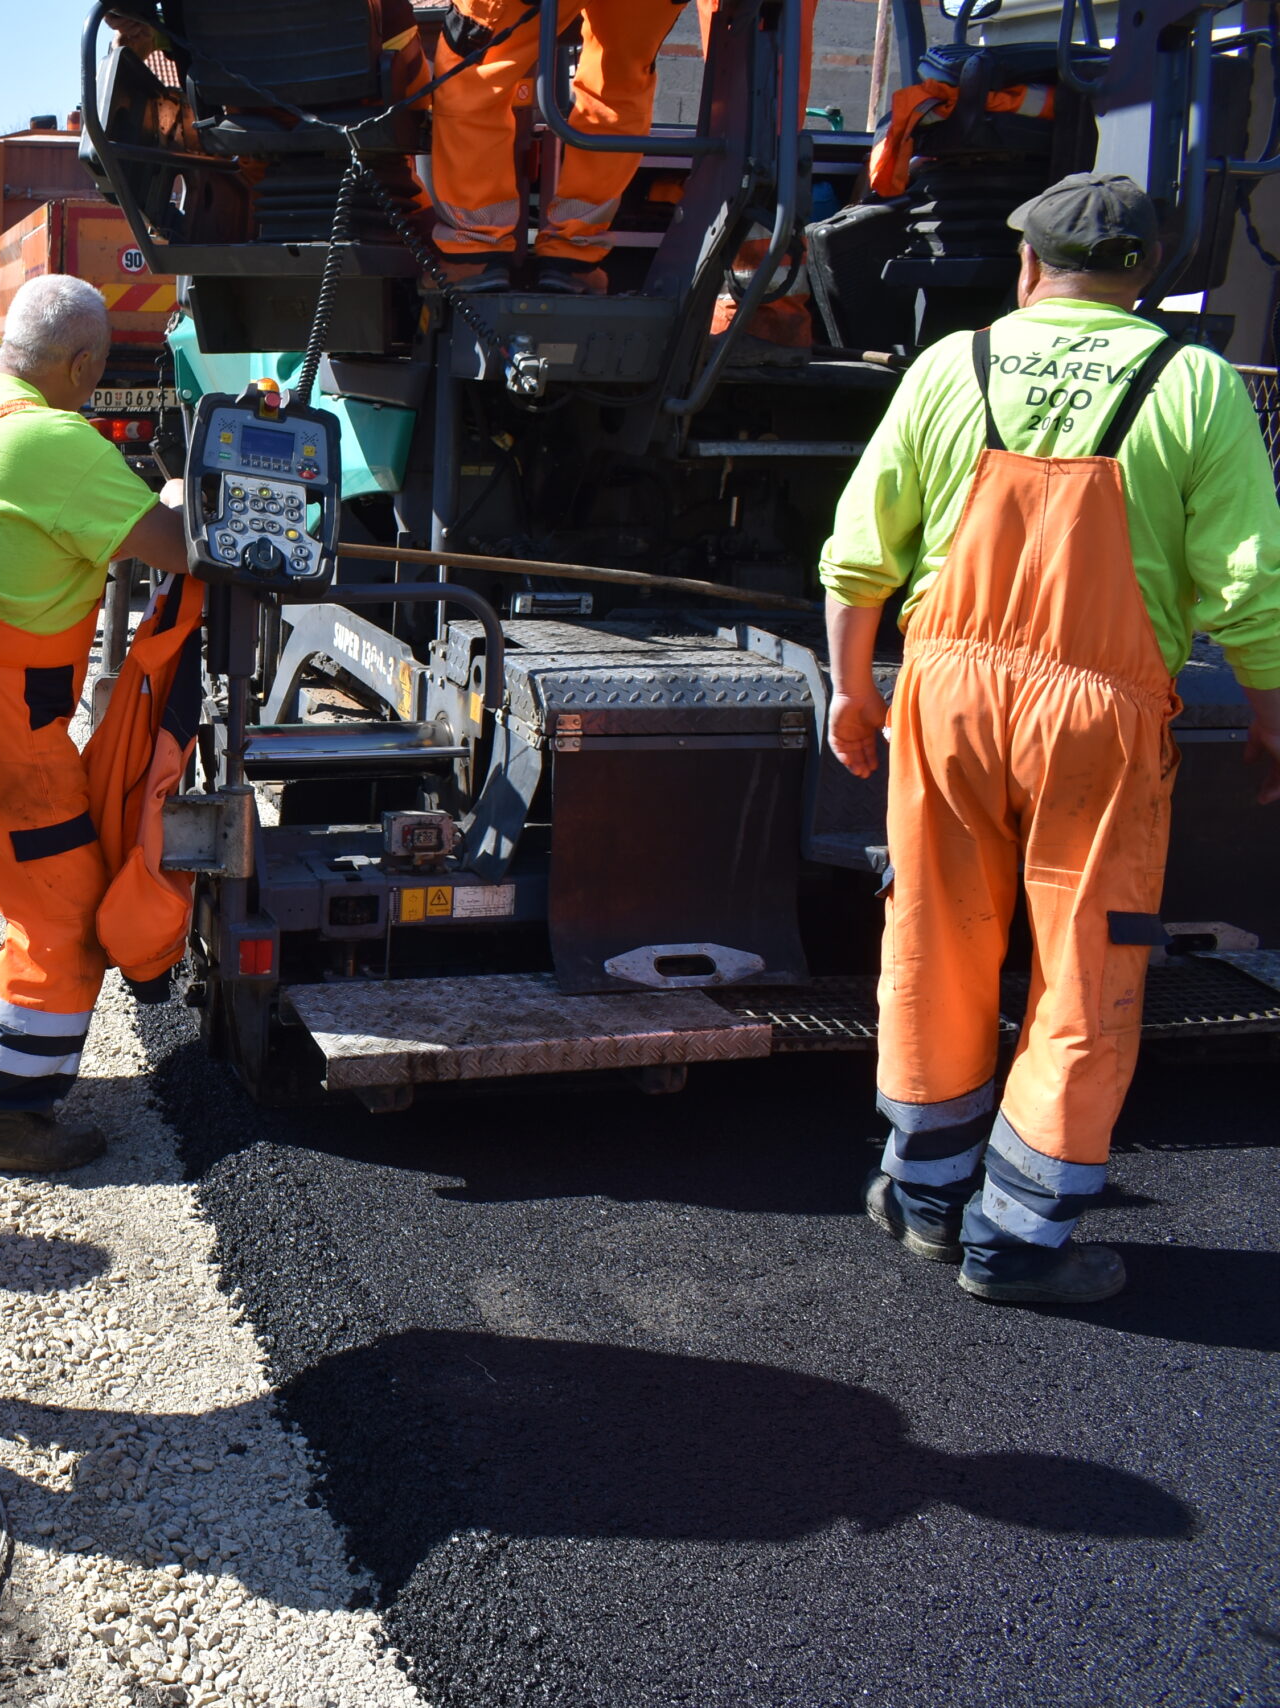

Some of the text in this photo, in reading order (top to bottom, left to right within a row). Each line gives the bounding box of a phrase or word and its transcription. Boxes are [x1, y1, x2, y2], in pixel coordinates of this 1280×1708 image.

[124, 251, 142, 269] 90
[1052, 336, 1109, 353] PZP
[1026, 386, 1092, 410] DOO
[1027, 415, 1074, 433] 2019
[333, 622, 360, 662] SUPER
